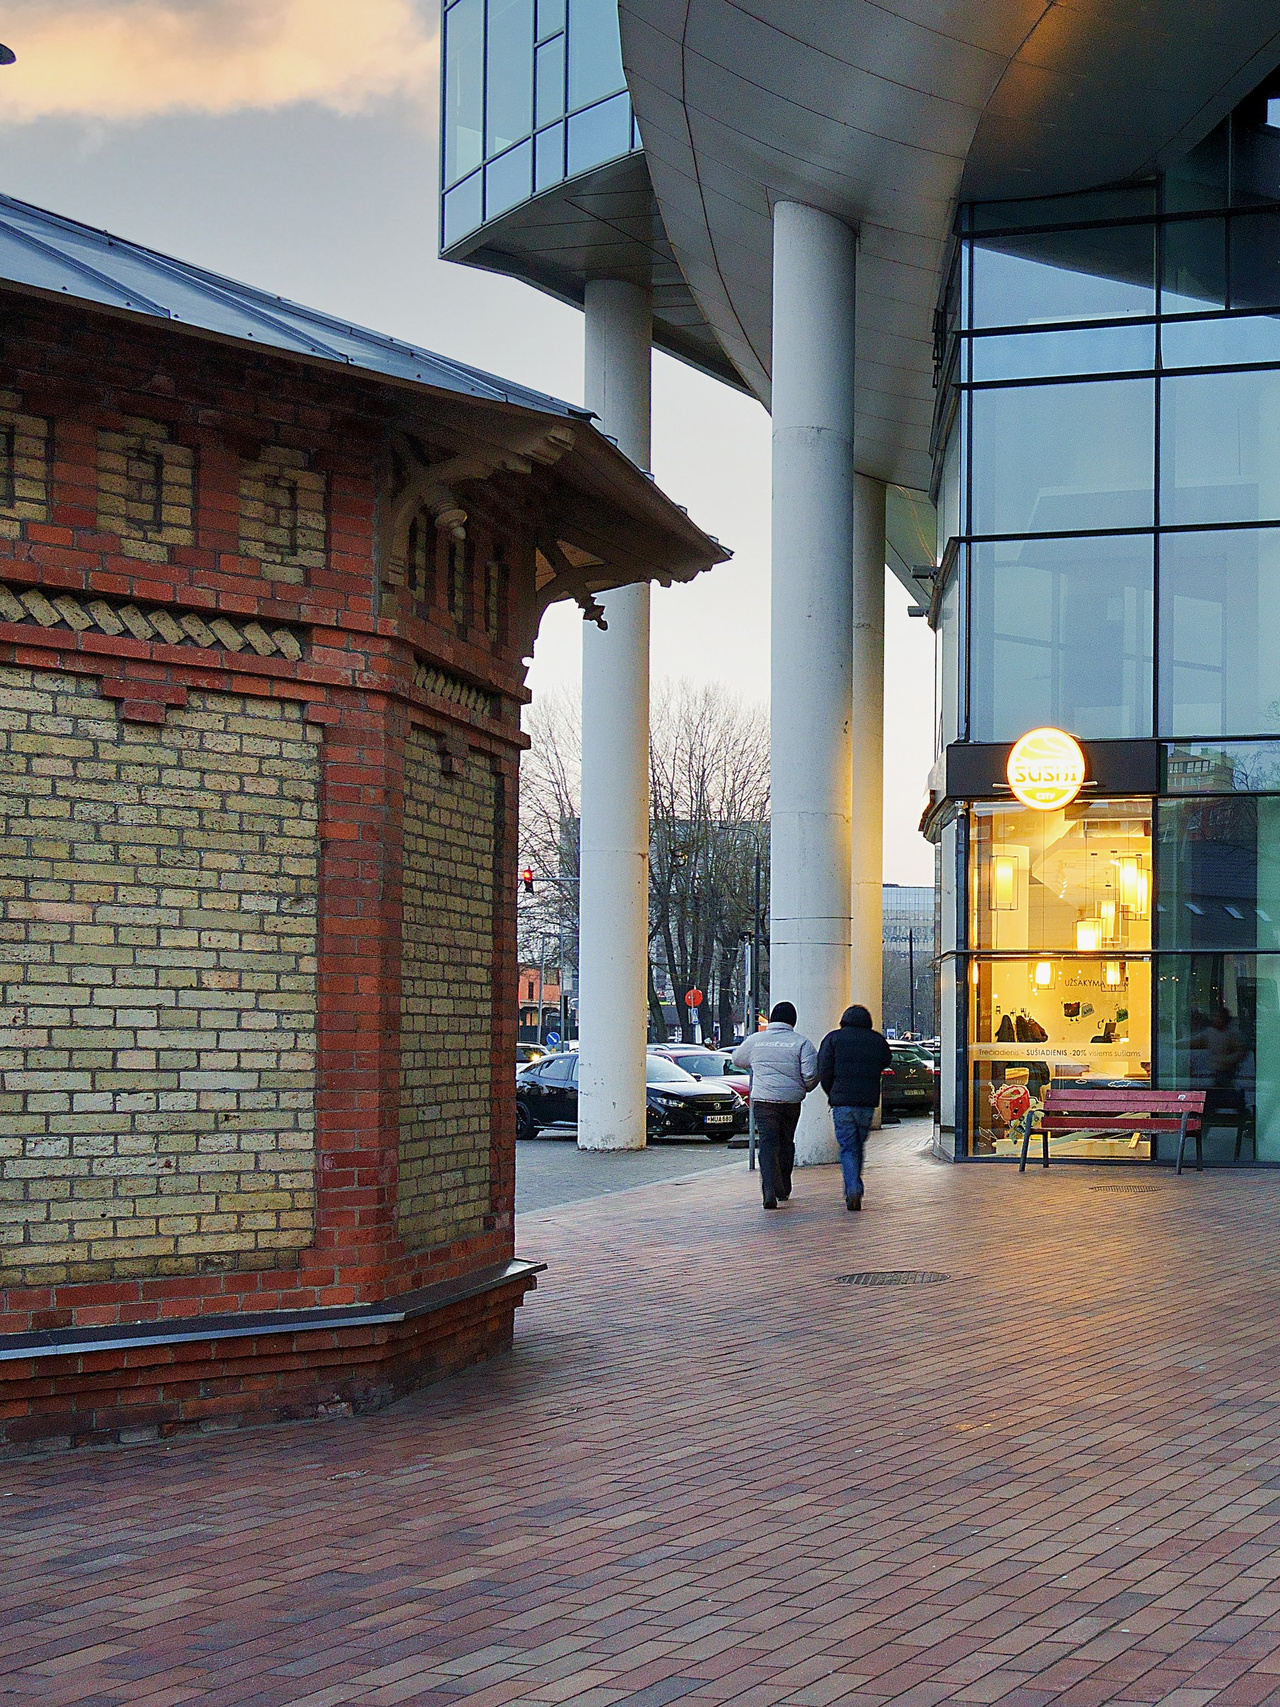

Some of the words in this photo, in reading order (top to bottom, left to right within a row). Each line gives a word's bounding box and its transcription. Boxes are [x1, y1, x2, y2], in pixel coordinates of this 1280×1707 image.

[1014, 765, 1078, 783] SUSHI
[1036, 793, 1056, 801] CITY
[1026, 1048, 1068, 1057] SUŠIADIENIS
